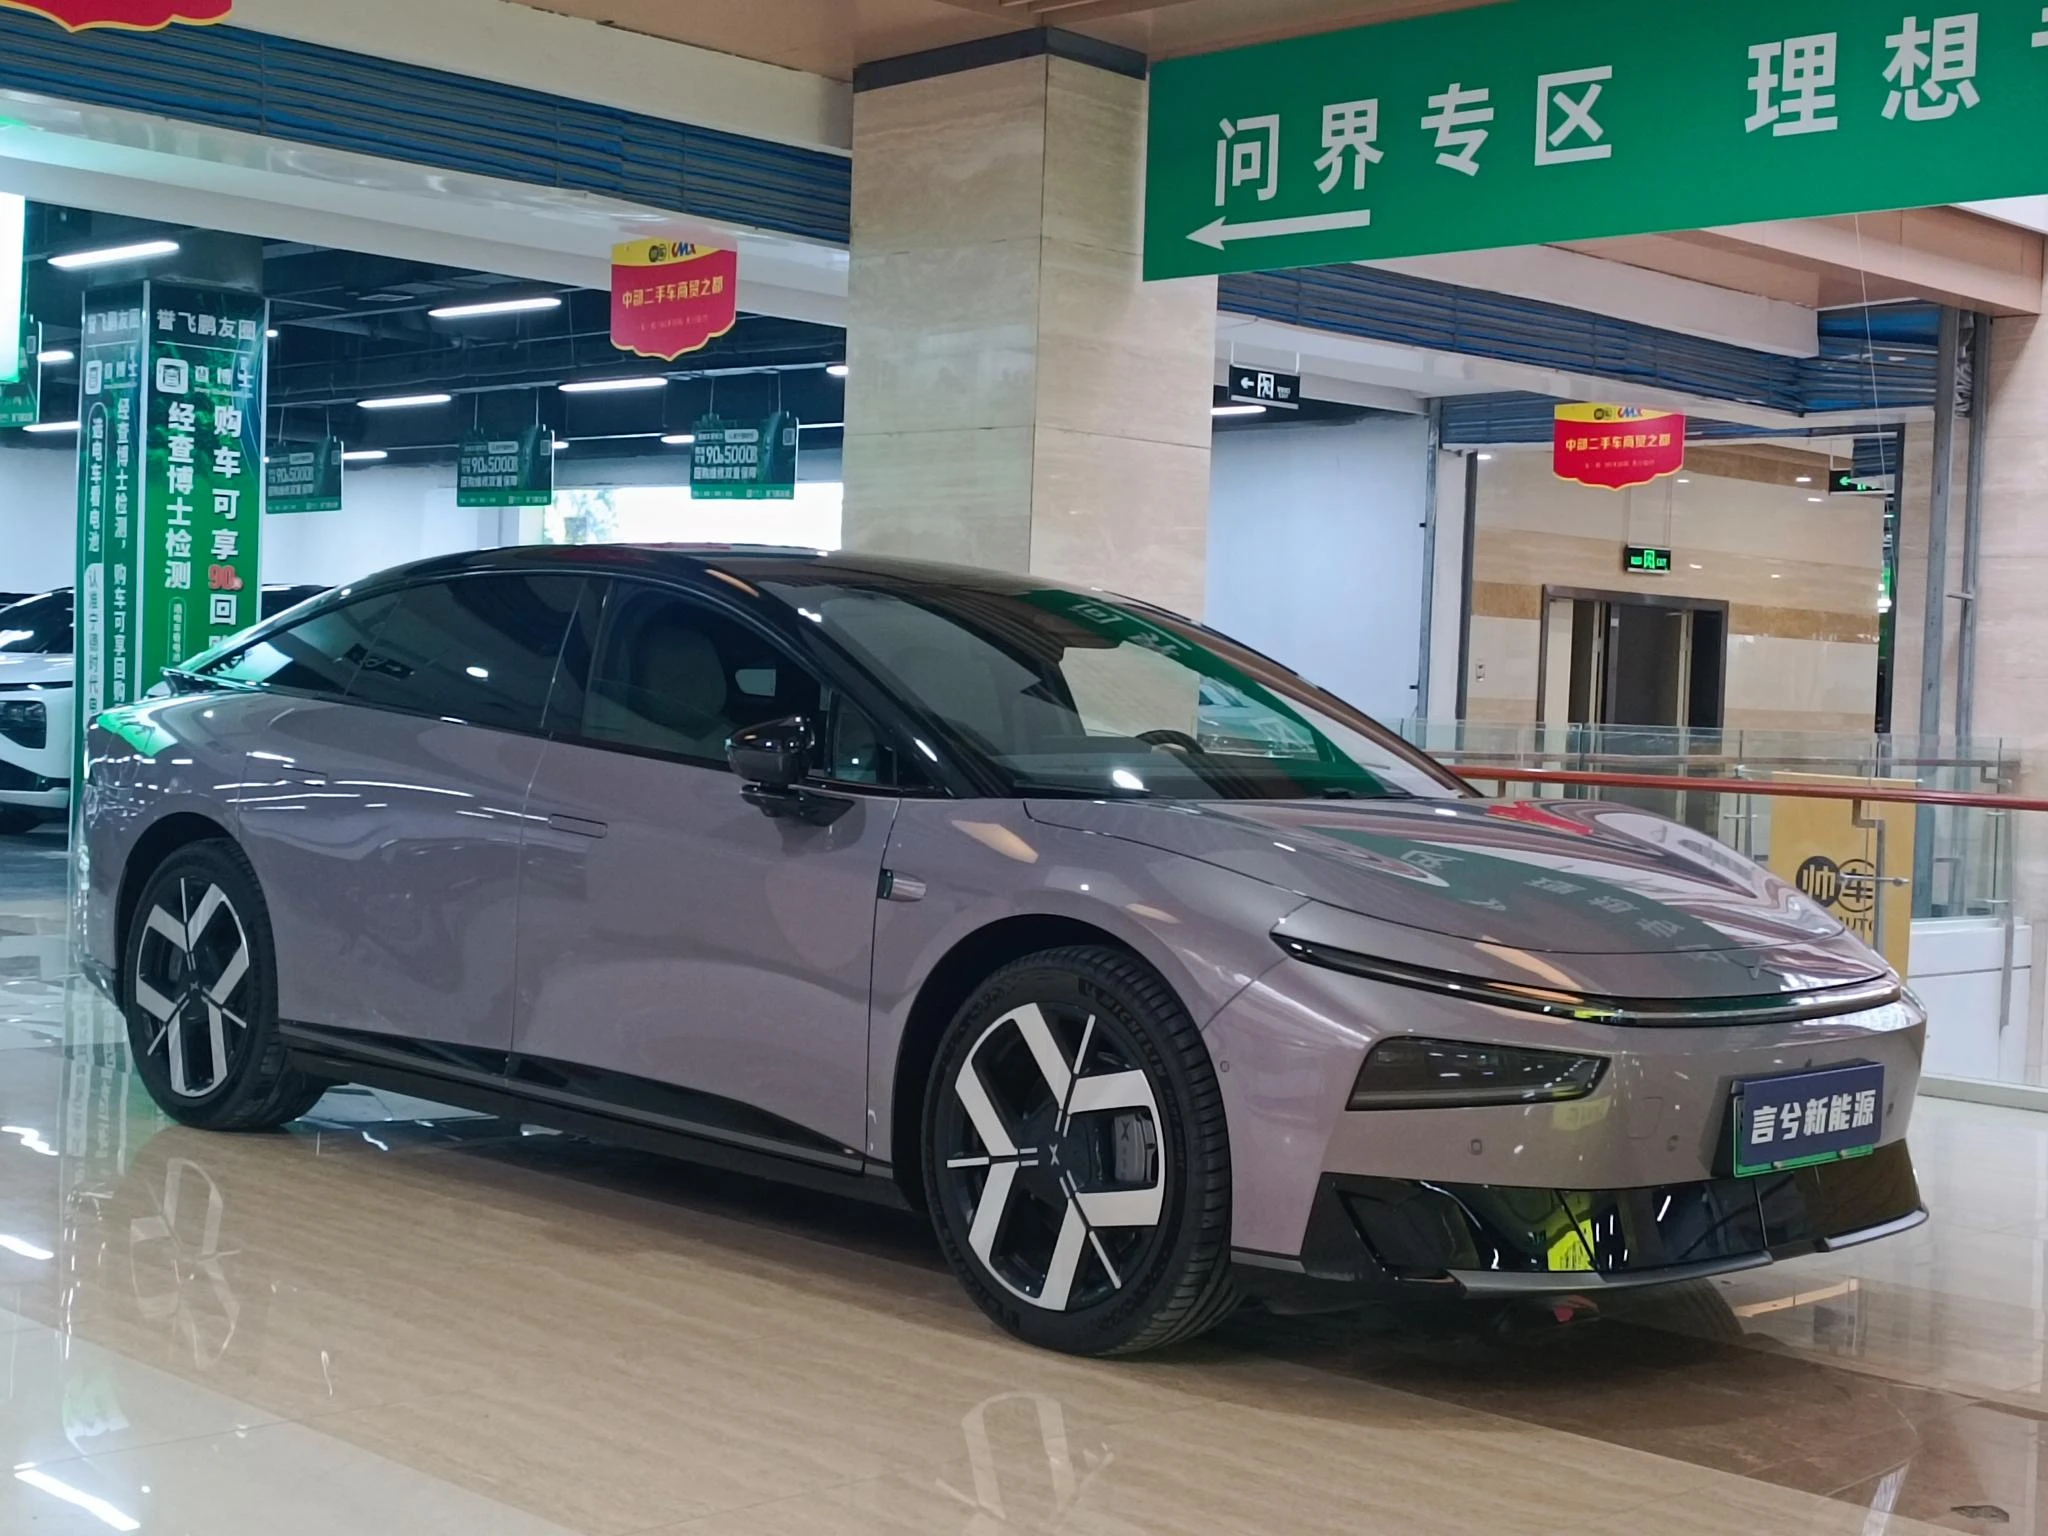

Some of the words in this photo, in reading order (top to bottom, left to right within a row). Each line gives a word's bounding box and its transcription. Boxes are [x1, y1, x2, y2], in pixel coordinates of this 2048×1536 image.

[1215, 65, 1613, 207] 问界专区
[164, 401, 196, 590] 经查博士检测
[1750, 1089, 1877, 1145] 言兮新能源
